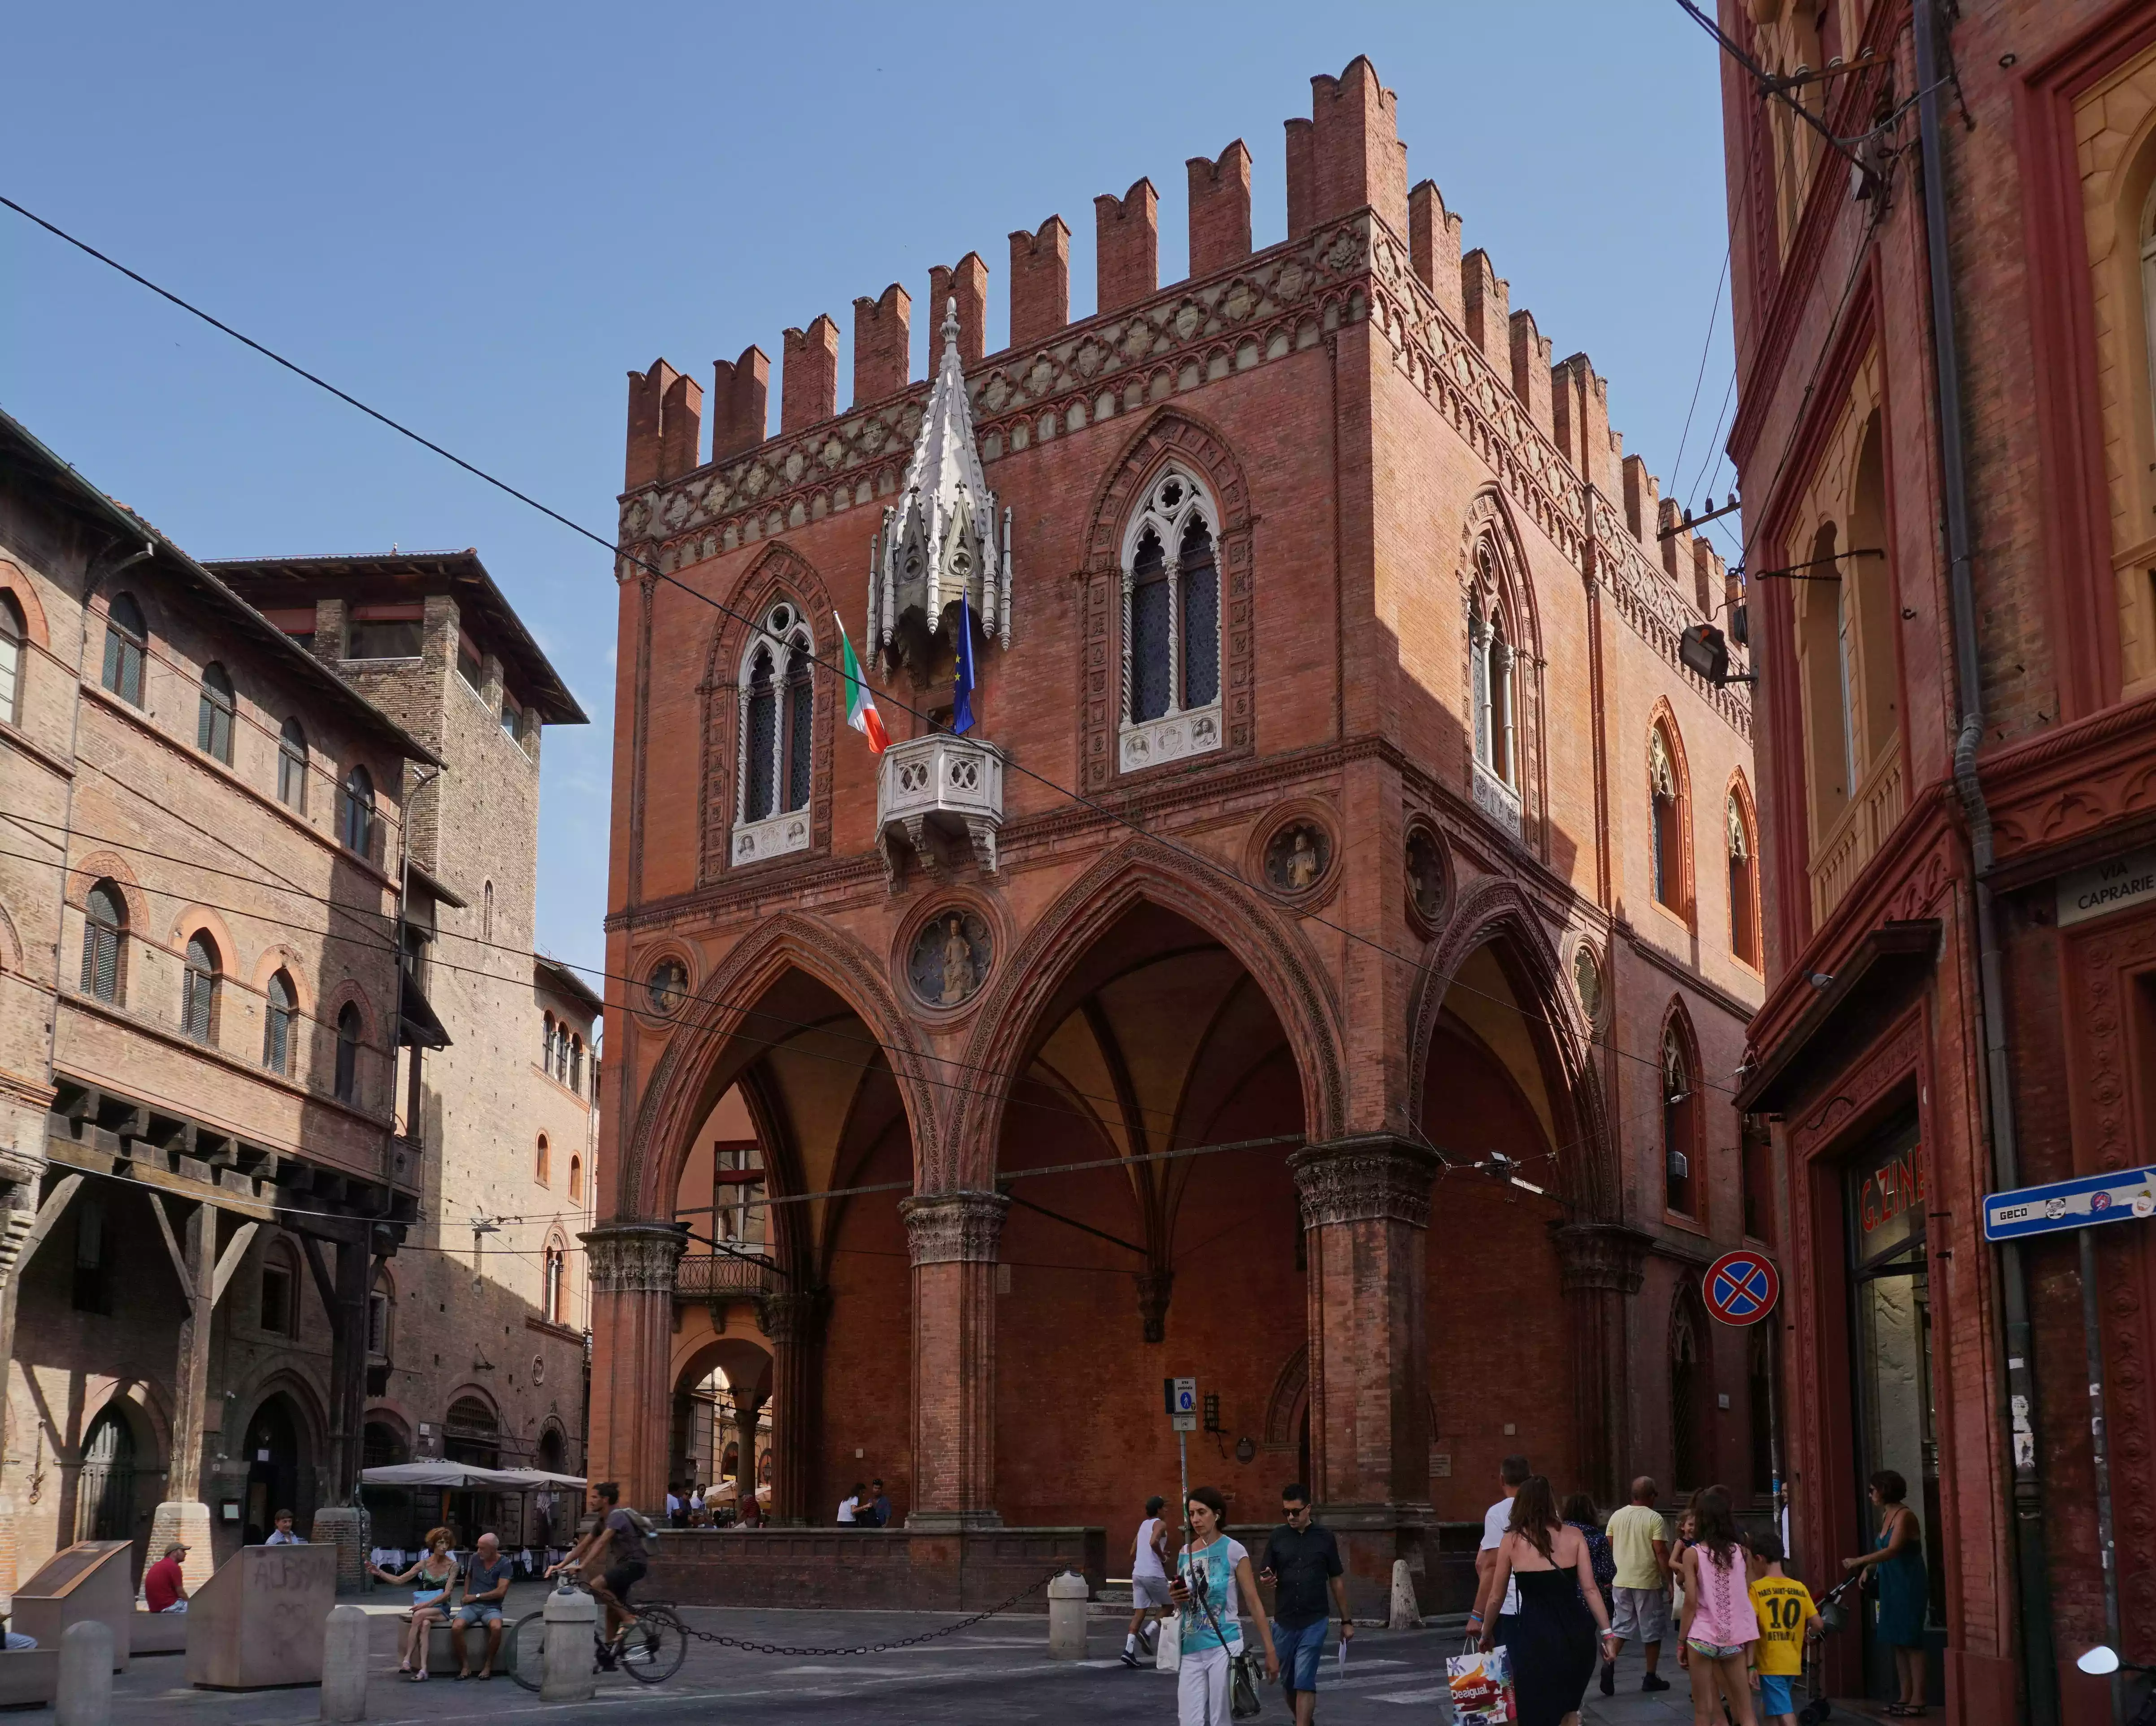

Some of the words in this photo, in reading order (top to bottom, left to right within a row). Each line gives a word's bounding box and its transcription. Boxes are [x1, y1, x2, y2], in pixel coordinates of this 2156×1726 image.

[2100, 861, 2129, 881] VIA
[2078, 875, 2155, 910] CAPRARIE
[1765, 1597, 1801, 1629] 10
